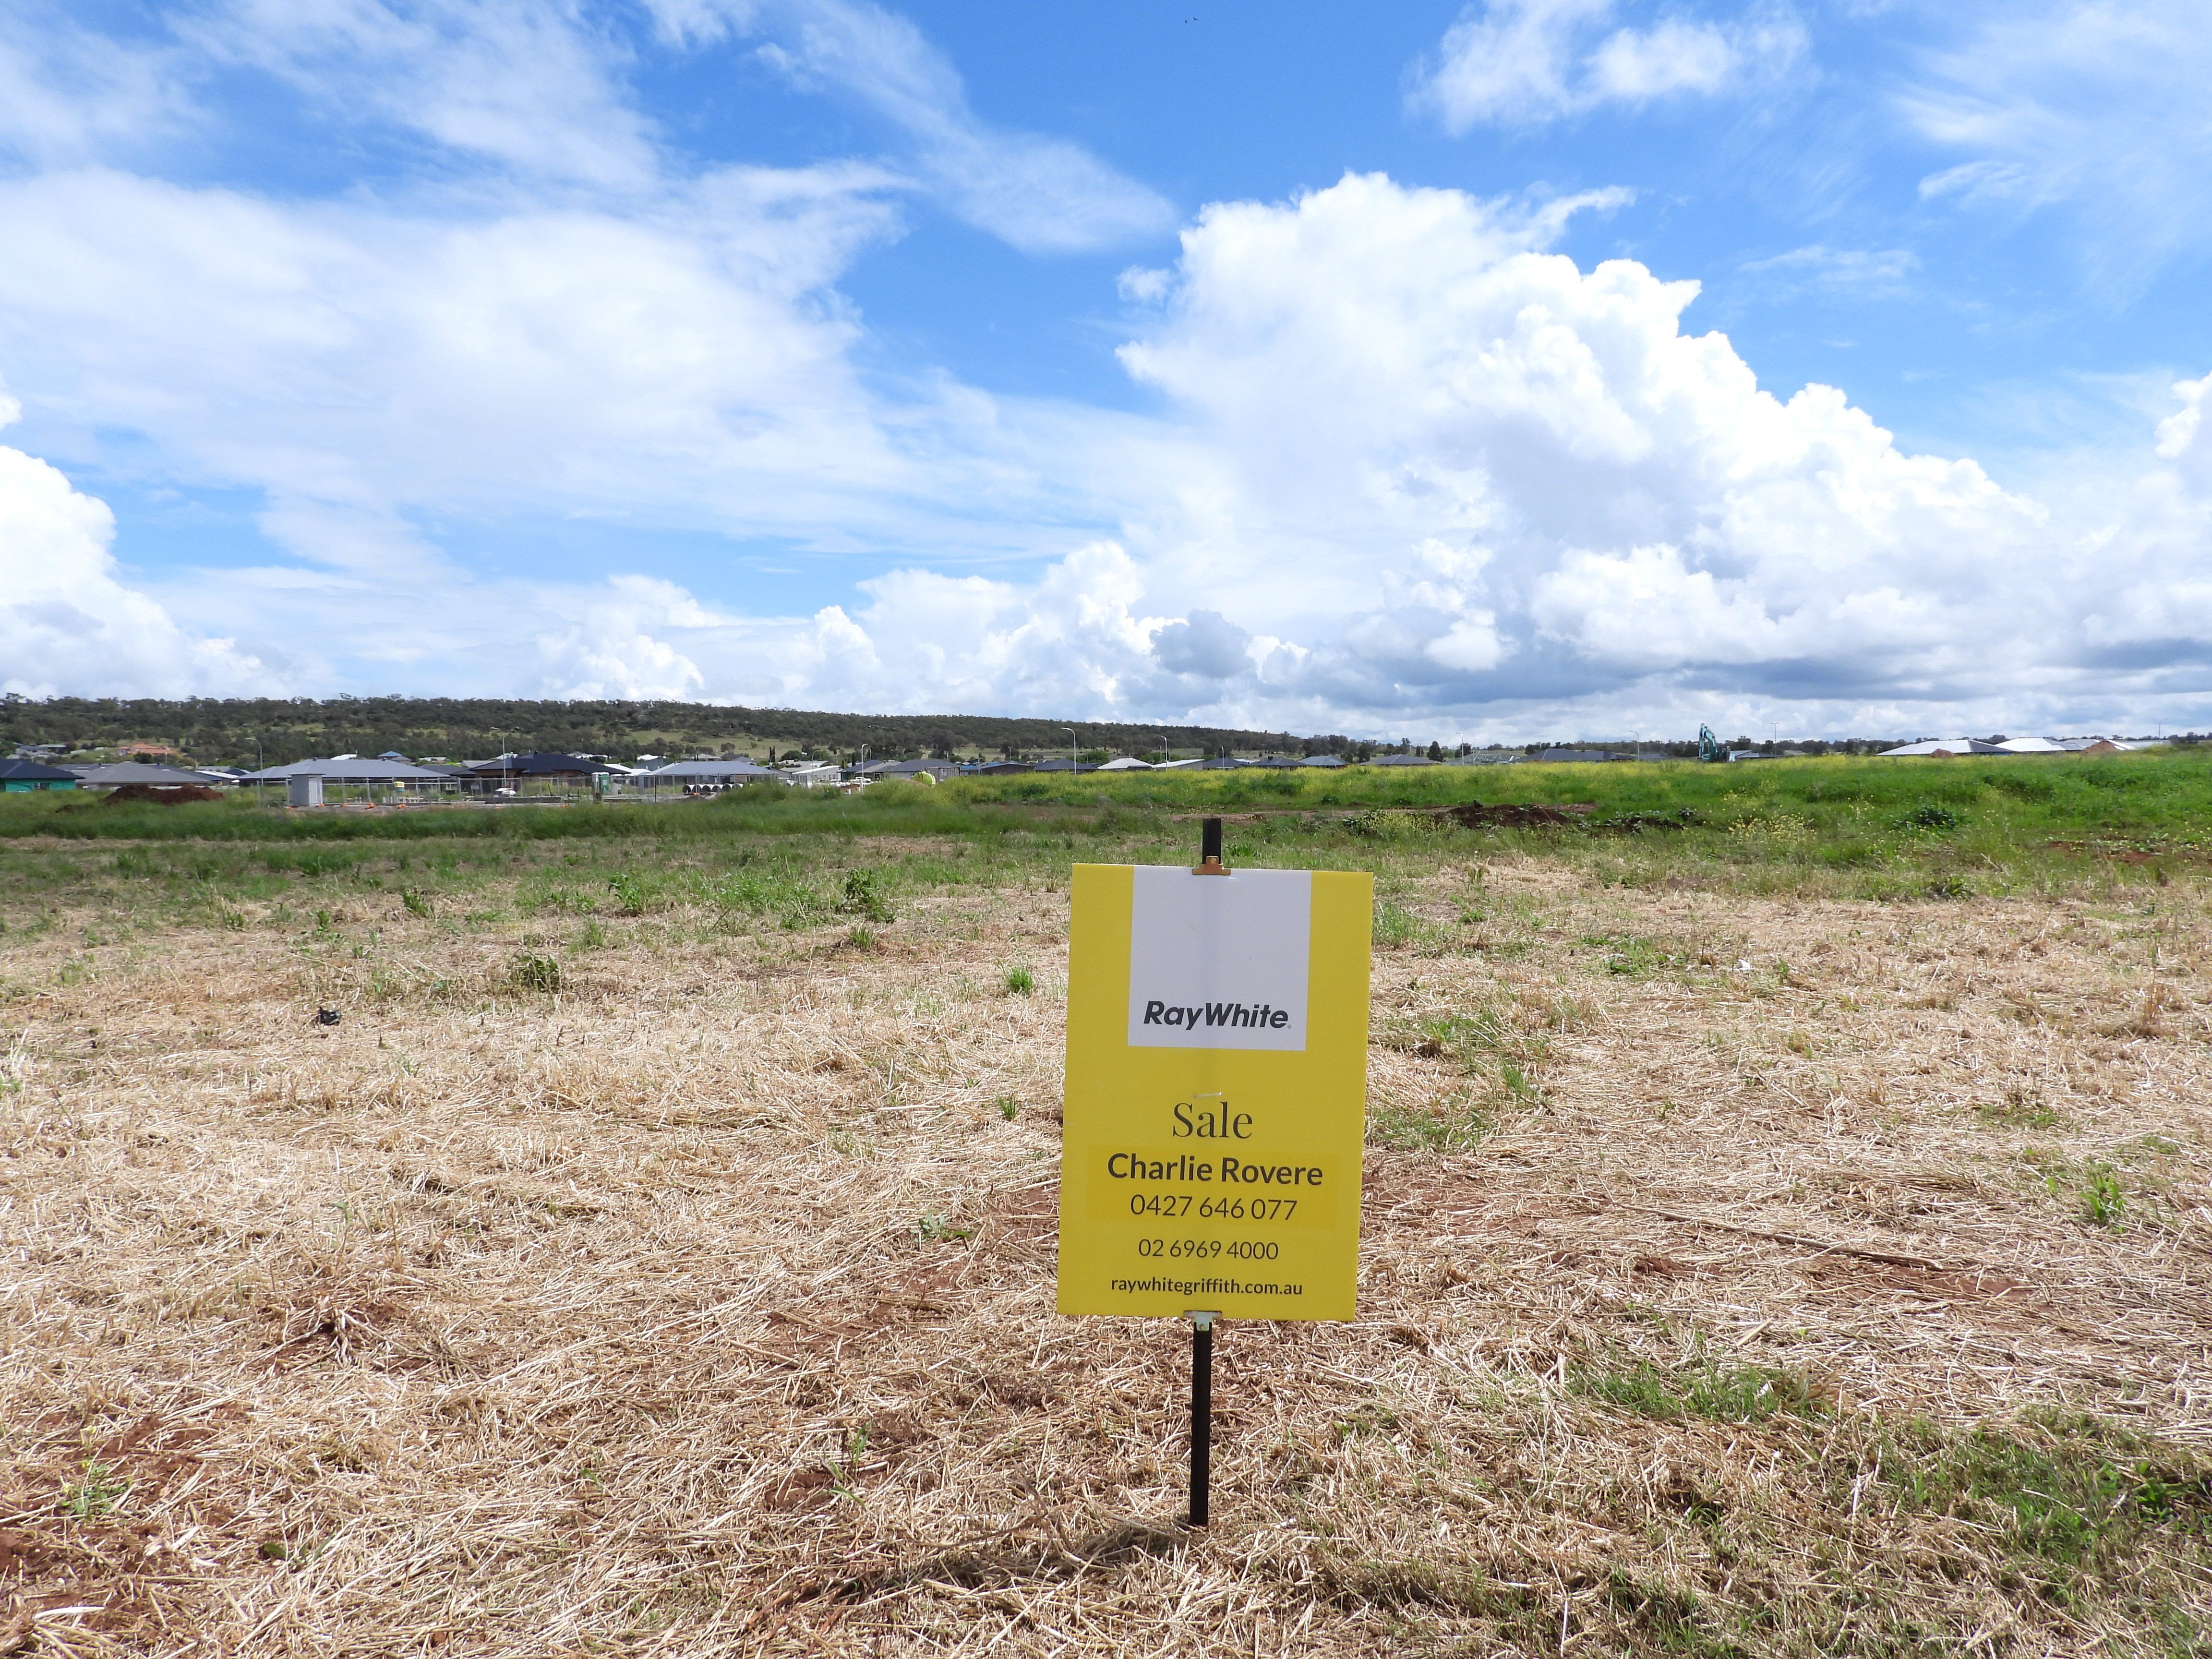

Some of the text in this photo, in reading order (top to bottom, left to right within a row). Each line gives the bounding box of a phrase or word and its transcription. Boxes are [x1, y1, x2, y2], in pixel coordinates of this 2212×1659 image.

[1143, 1000, 1288, 1031] RayWhite
[1173, 1101, 1252, 1139] Sale
[1107, 1153, 1323, 1186] Charlie Rovere
[1130, 1194, 1297, 1220] 0427 646 077
[1139, 1239, 1278, 1260] 02 6969 4000
[1111, 1276, 1302, 1296] raywhitegriffith.com.au
